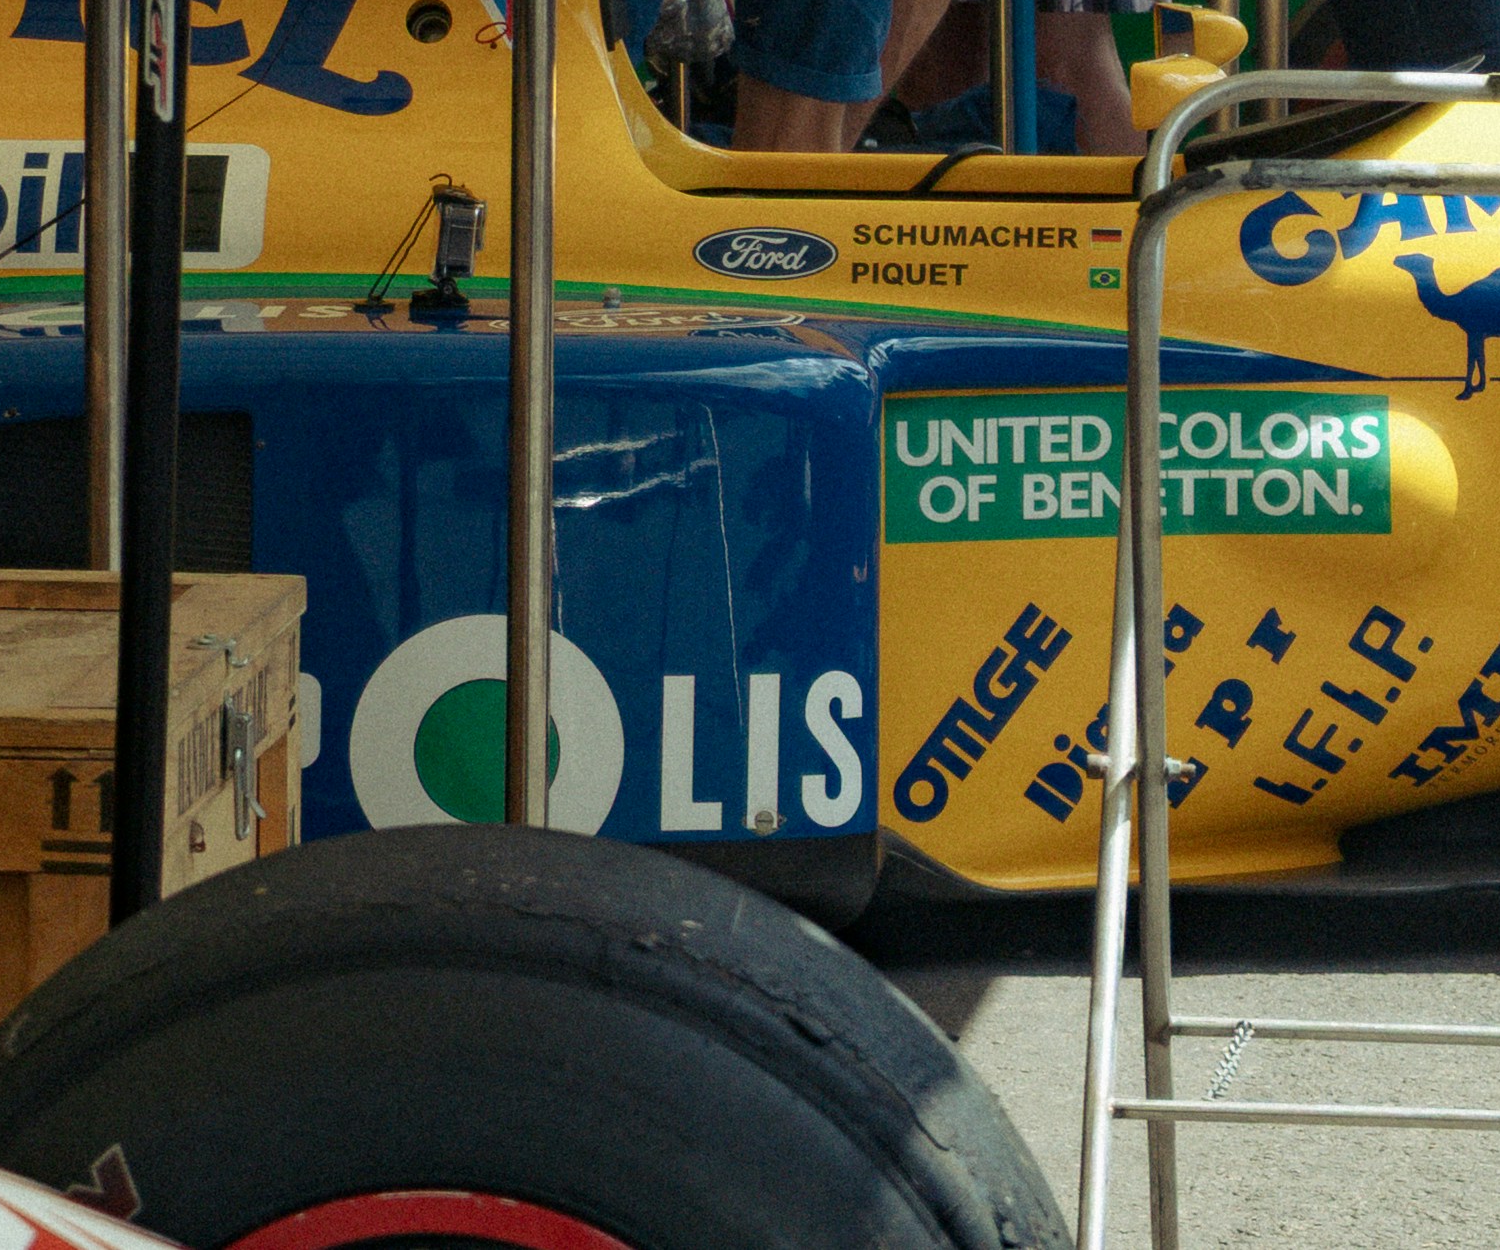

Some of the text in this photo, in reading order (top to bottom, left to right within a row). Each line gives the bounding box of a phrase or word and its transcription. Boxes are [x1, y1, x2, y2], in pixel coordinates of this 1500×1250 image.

[725, 236, 809, 271] Ford
[851, 223, 1079, 251] SCHUMACHER
[850, 261, 970, 288] PIQUET
[896, 414, 1113, 468] UNITED
[918, 473, 998, 524] OF
